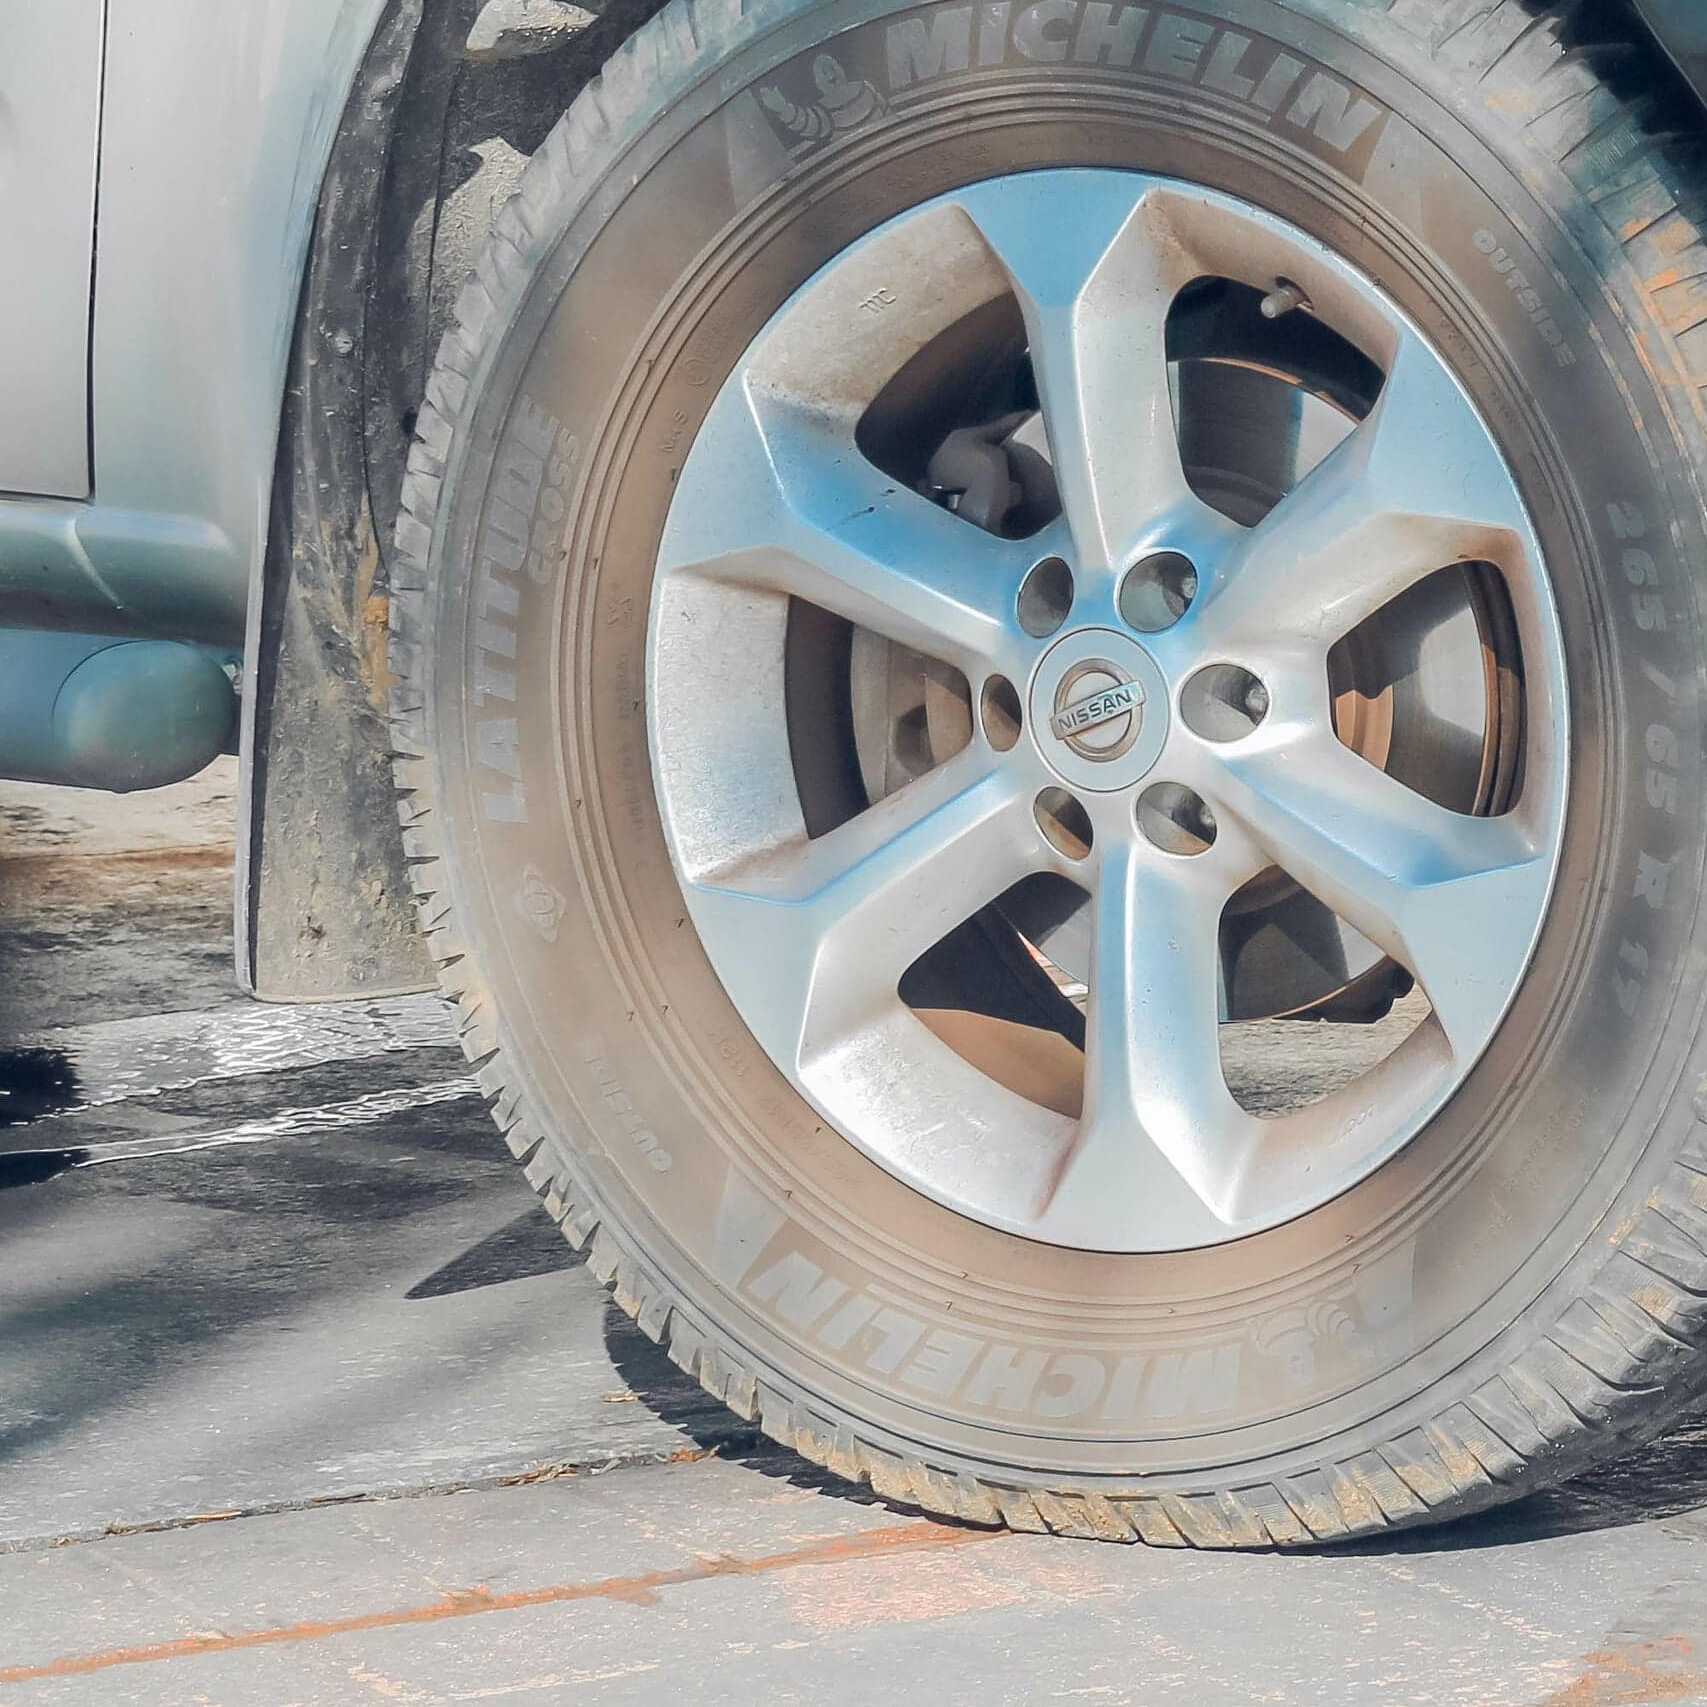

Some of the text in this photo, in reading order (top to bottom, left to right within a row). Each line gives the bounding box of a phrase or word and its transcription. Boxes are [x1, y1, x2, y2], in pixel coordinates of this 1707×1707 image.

[527, 427, 581, 585] CROSS
[472, 394, 561, 824] LATITUDE
[1057, 689, 1133, 730] NISSAN
[748, 1250, 1247, 1421] MICHELIN
